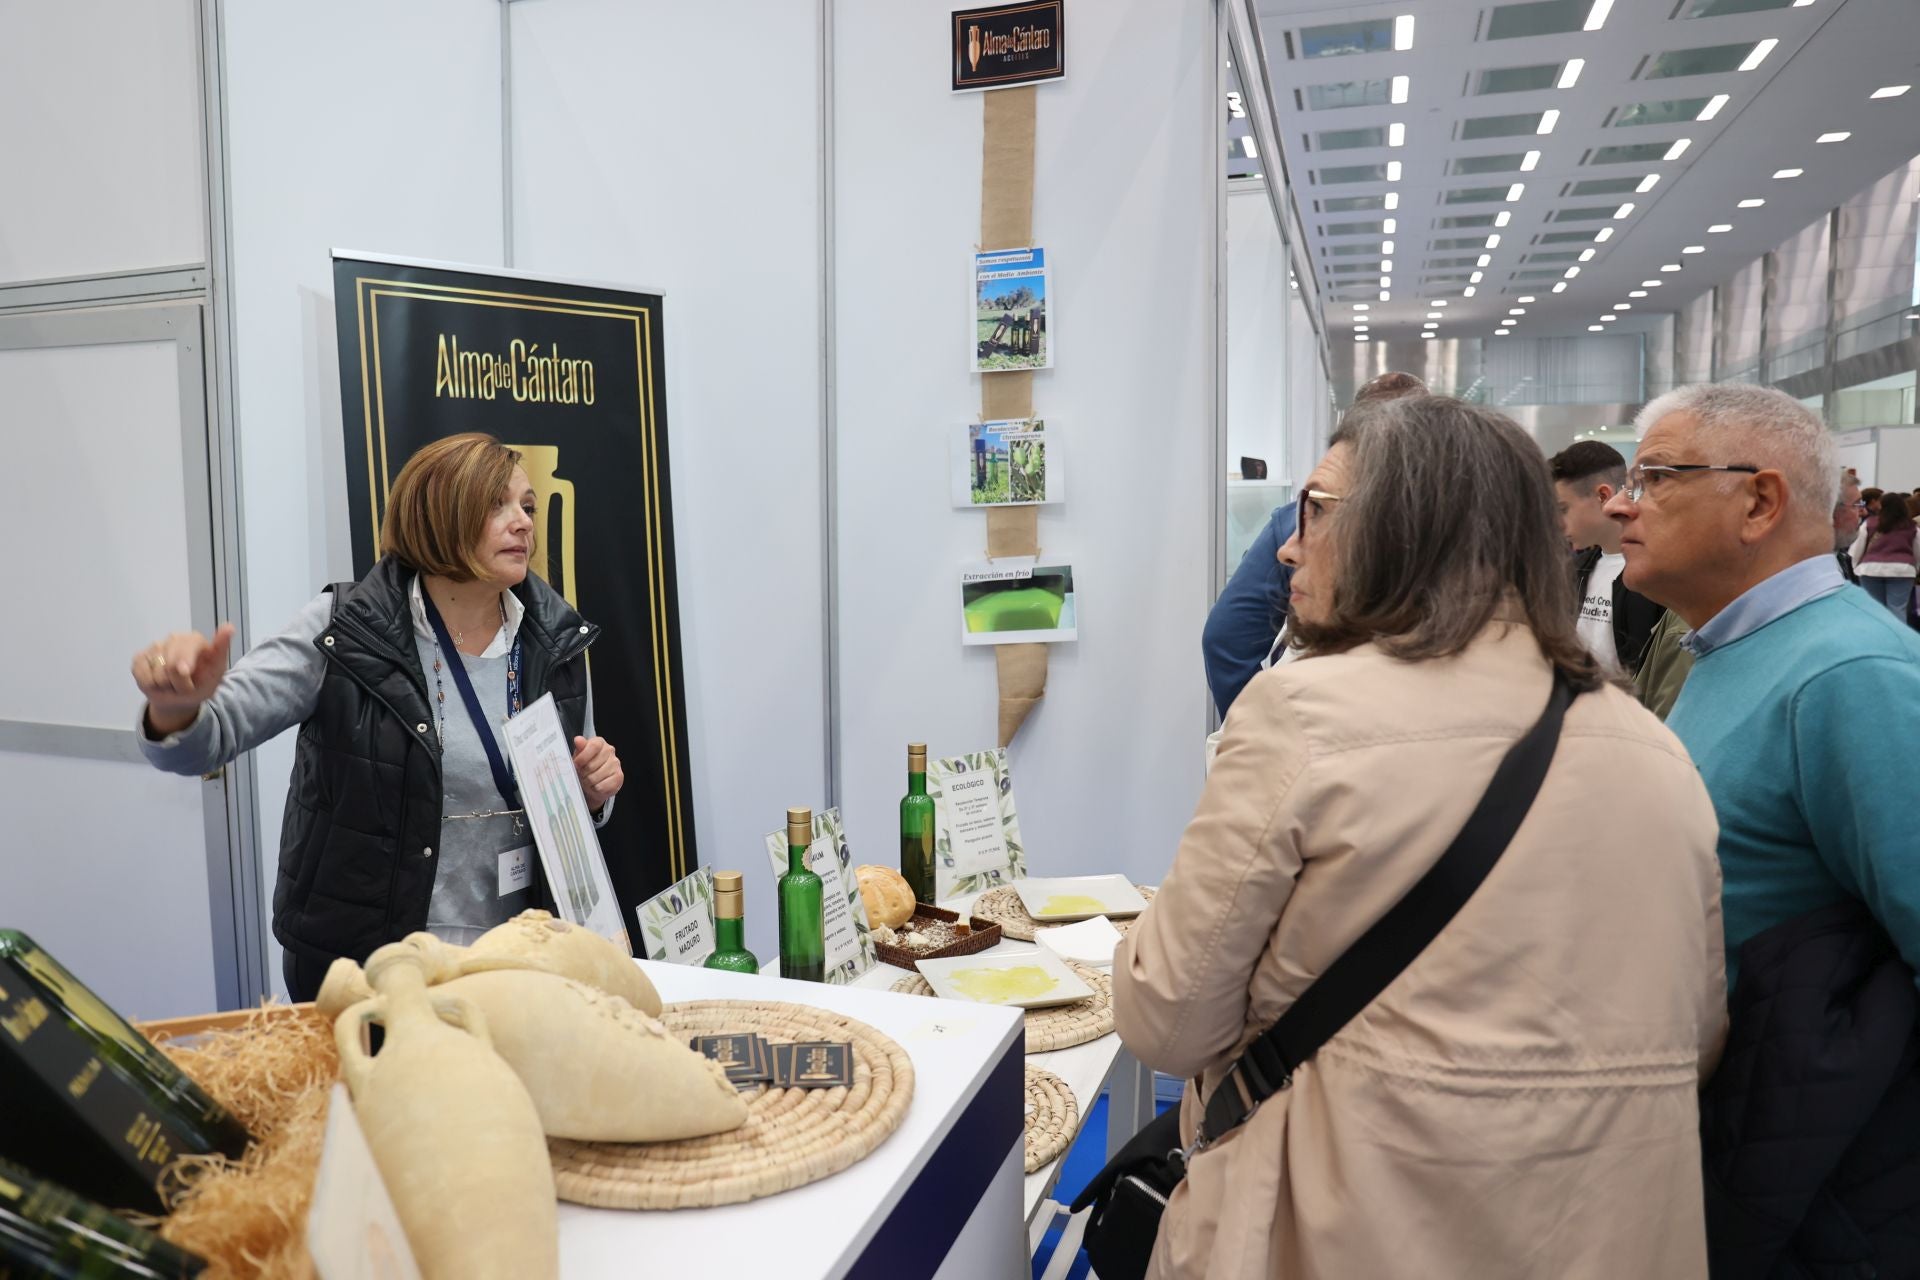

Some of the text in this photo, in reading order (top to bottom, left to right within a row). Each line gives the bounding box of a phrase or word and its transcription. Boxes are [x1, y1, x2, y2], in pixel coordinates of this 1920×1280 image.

[983, 30, 1007, 56] Alma
[1013, 24, 1050, 53] Cántaro
[435, 333, 595, 406] Alma de Cántaro
[963, 571, 1003, 580] Extracción
[1585, 596, 1595, 604] ed
[952, 780, 984, 791] ECOLÓGICO
[675, 920, 698, 942] FRUTADO
[678, 934, 701, 954] MADURO
